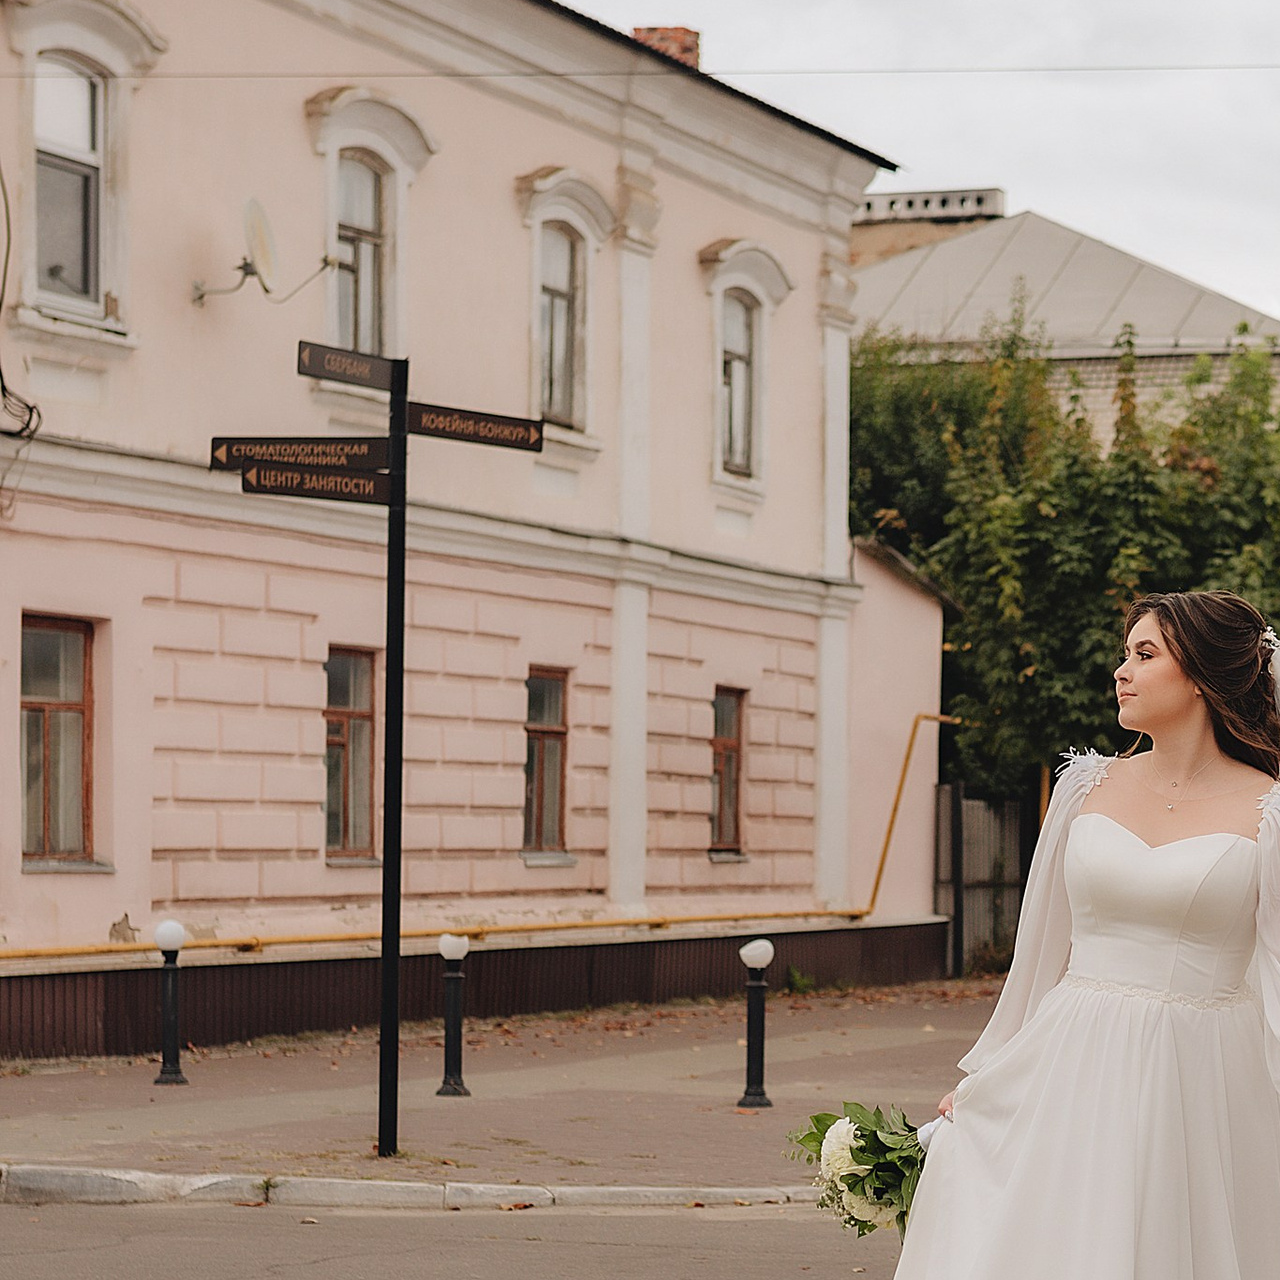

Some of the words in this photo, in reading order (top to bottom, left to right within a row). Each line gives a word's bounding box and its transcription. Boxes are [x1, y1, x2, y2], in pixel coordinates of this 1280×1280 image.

[324, 354, 371, 379] СБЕРБАНК
[421, 413, 474, 435] КОФЕЙНЯ
[231, 443, 369, 457] СТОМАТОЛОГИЧЕСКАЯ
[260, 469, 300, 488] ЦЕНТР
[302, 473, 375, 495] ЗАНЯТОСТИ
